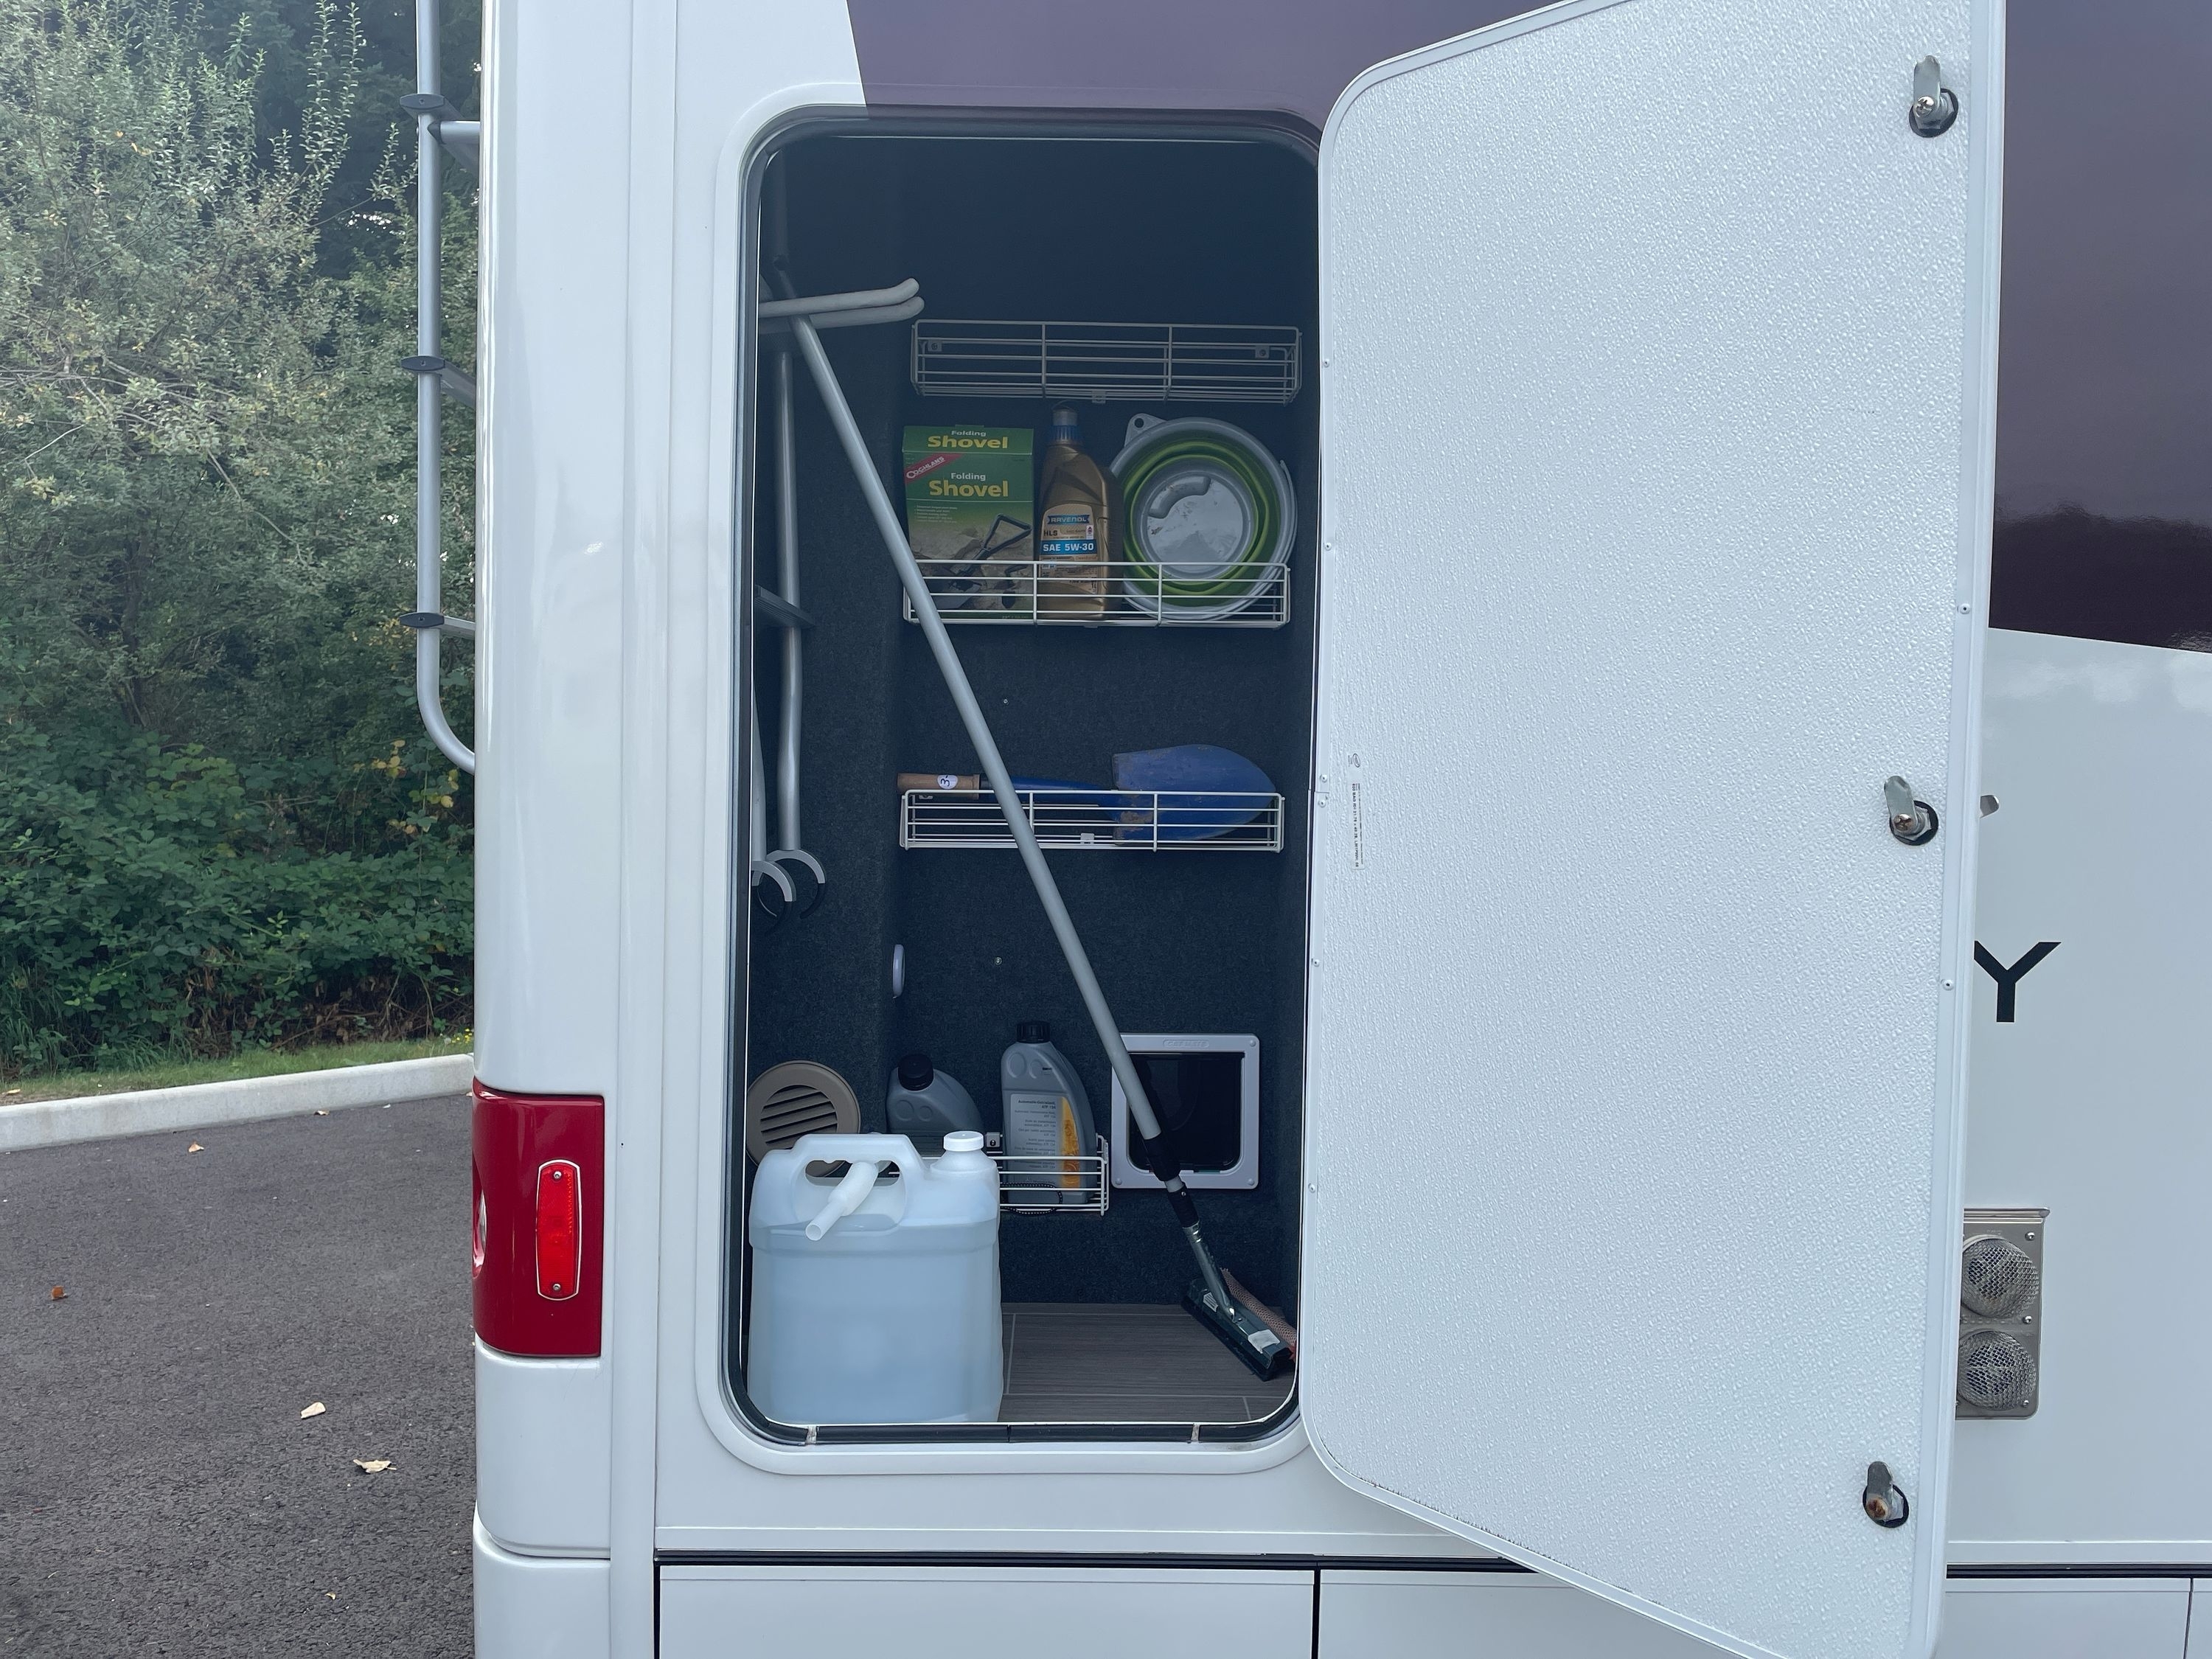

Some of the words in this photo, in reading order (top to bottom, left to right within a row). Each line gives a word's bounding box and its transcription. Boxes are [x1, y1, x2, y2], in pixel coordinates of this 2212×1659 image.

[928, 435, 1009, 449] Shovel
[950, 473, 987, 481] Folding
[929, 480, 1009, 497] Shovel
[1043, 543, 1061, 552] SAE
[1065, 543, 1094, 551] 5W-30
